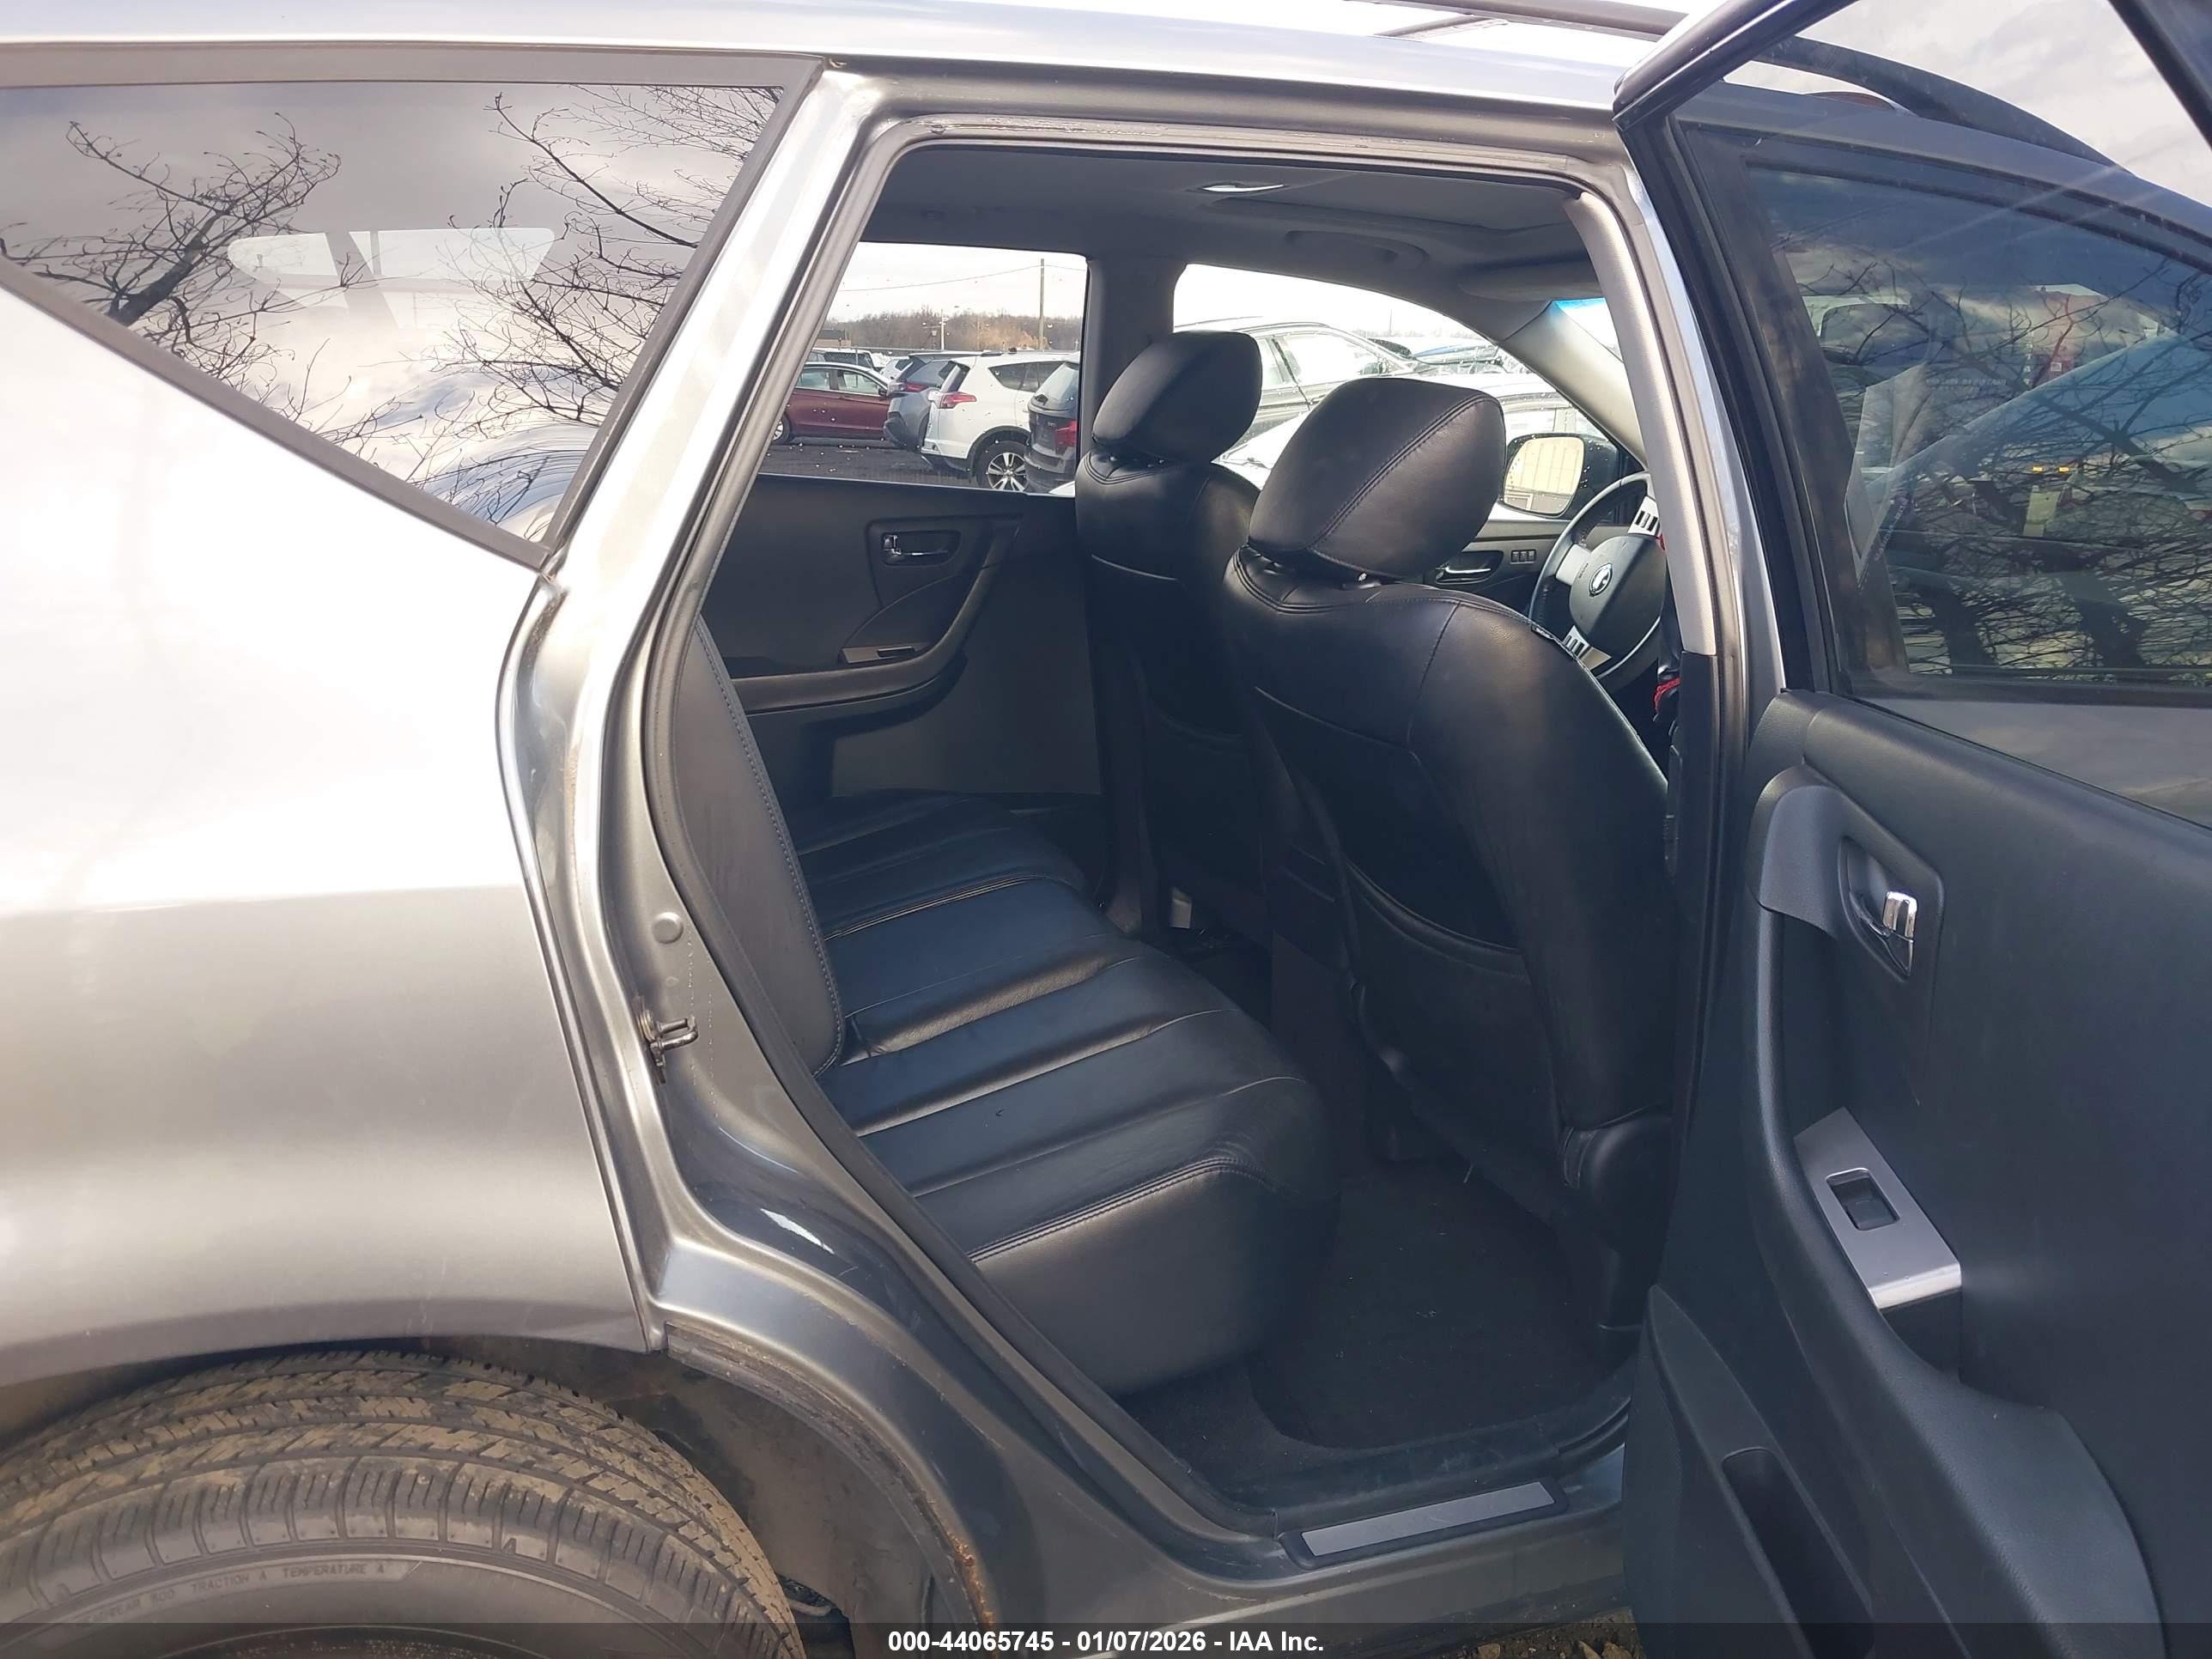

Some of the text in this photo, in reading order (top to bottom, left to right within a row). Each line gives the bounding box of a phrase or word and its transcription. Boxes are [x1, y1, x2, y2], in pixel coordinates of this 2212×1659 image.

[192, 1573, 250, 1594] TRACTION
[259, 1571, 267, 1581] A
[283, 1564, 368, 1578] TEMPERATURE
[377, 1564, 385, 1574] A
